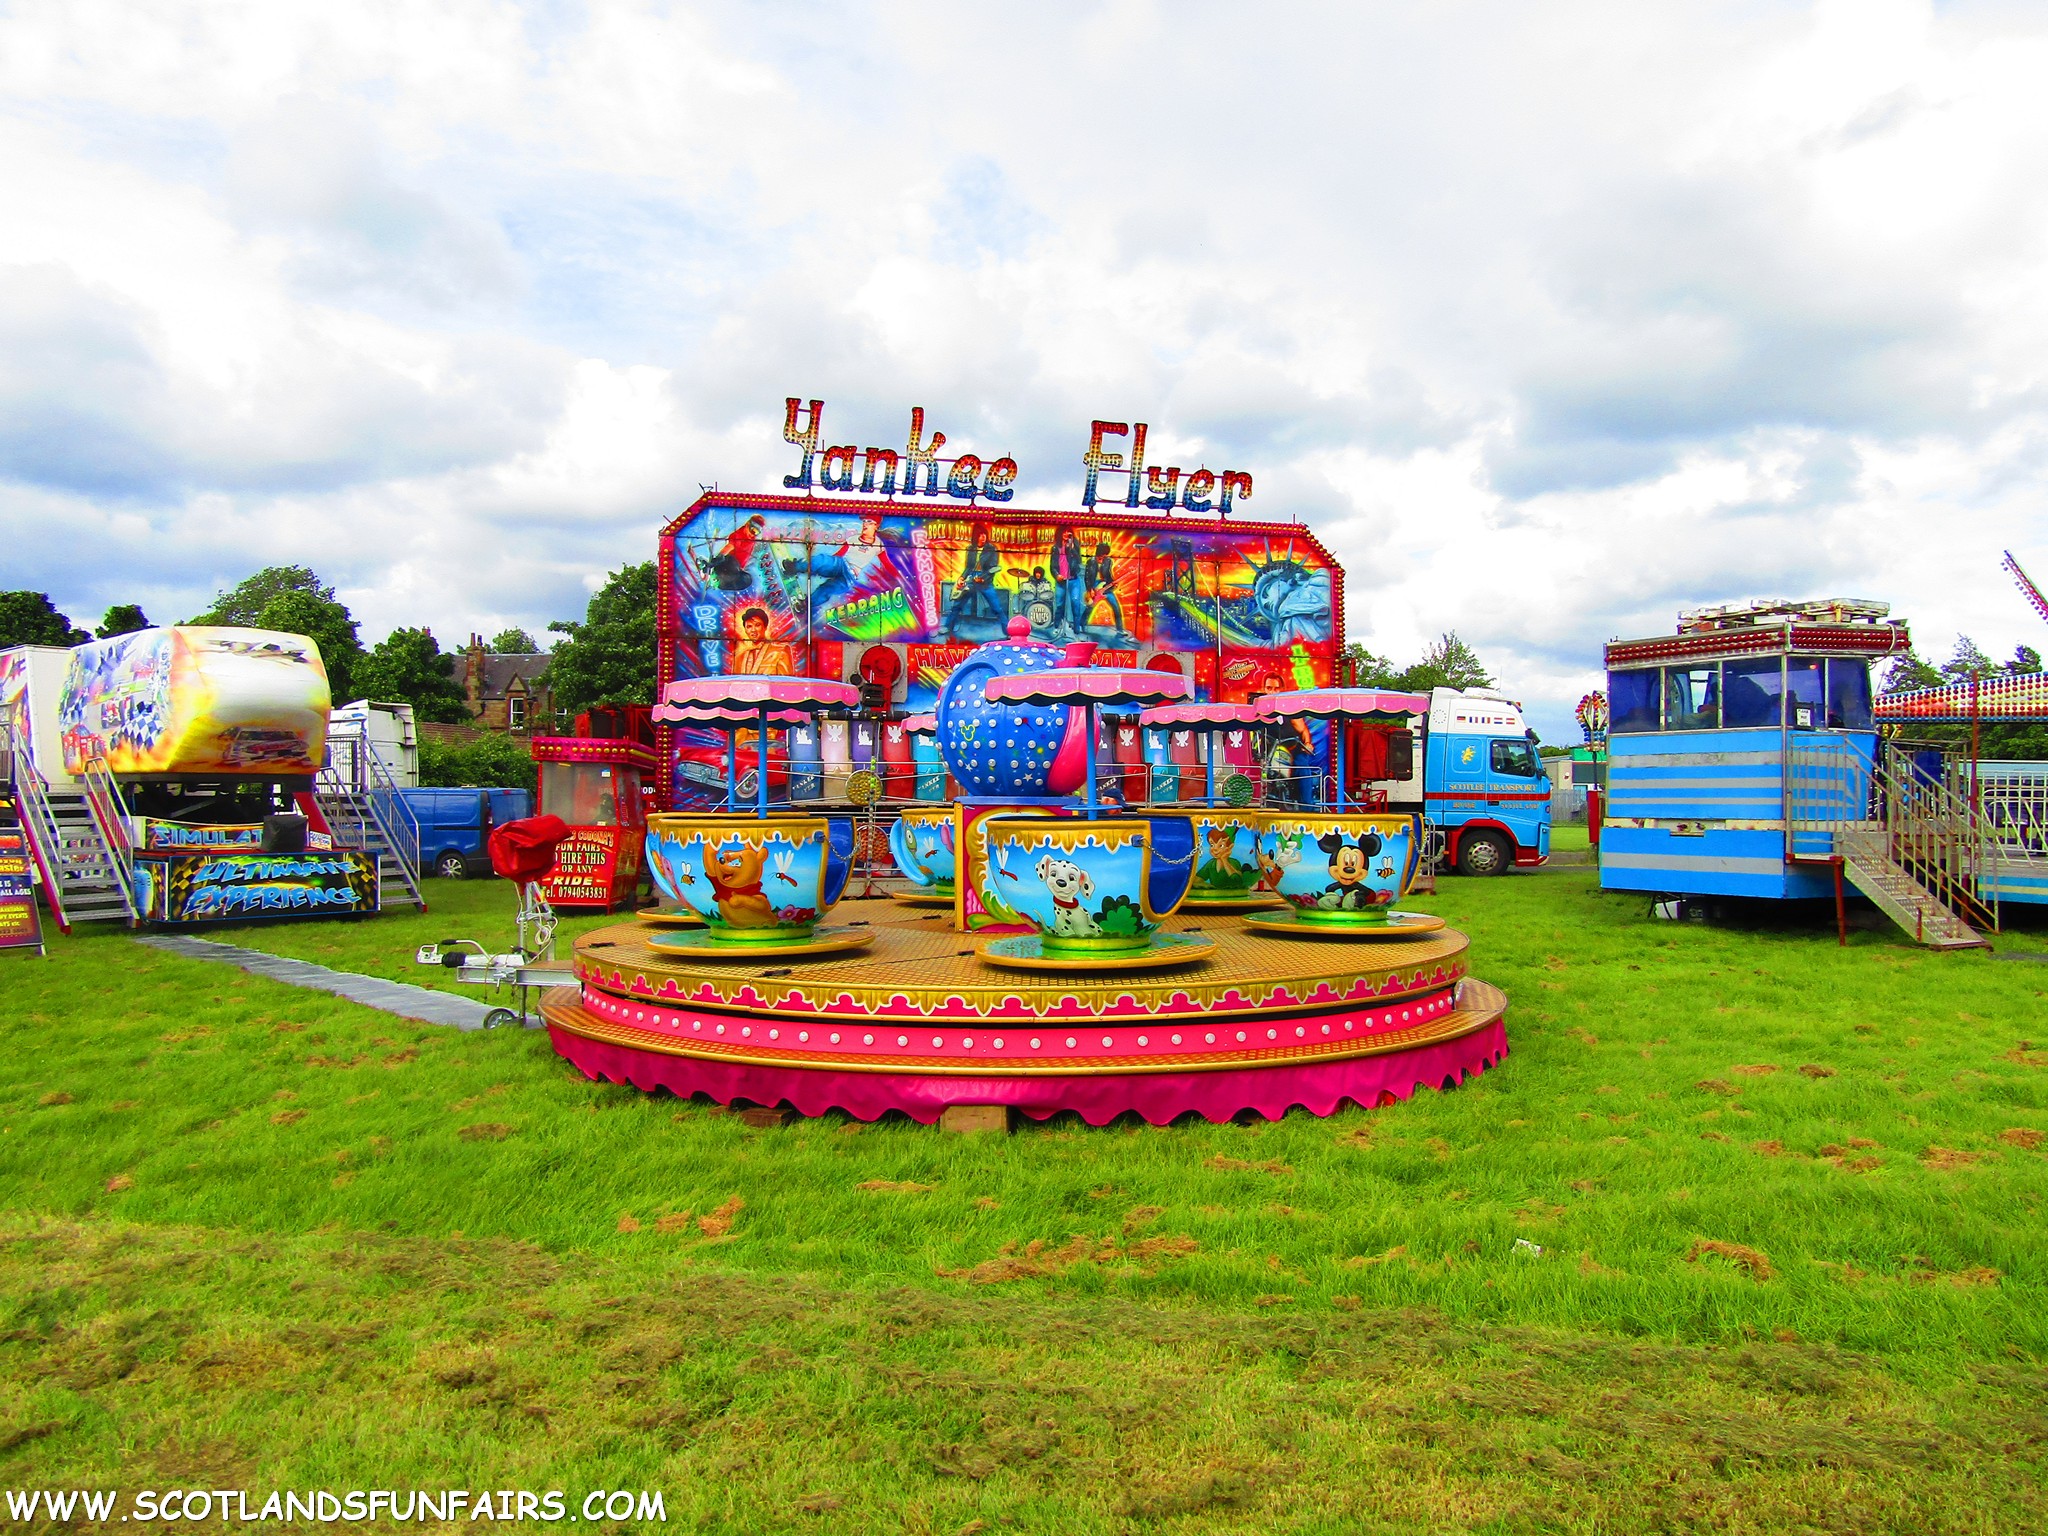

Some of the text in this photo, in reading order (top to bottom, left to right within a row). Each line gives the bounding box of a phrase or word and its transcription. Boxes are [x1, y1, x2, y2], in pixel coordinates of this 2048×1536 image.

[783, 397, 1253, 513] Yankee Flyer
[911, 529, 939, 627] RAMONES
[825, 586, 904, 622] KERRANG
[915, 648, 971, 669] HAV
[1489, 783, 1537, 792] TRANSPORT
[154, 826, 264, 847] SIMULAT
[555, 842, 600, 852] FUN FAIRS
[561, 851, 582, 864] HIRE
[585, 852, 606, 865] THIS
[191, 860, 362, 884] ULTIMATE
[561, 864, 593, 874] OR ANY
[553, 876, 593, 886] RIDE
[182, 884, 362, 916] EXPERIENCE
